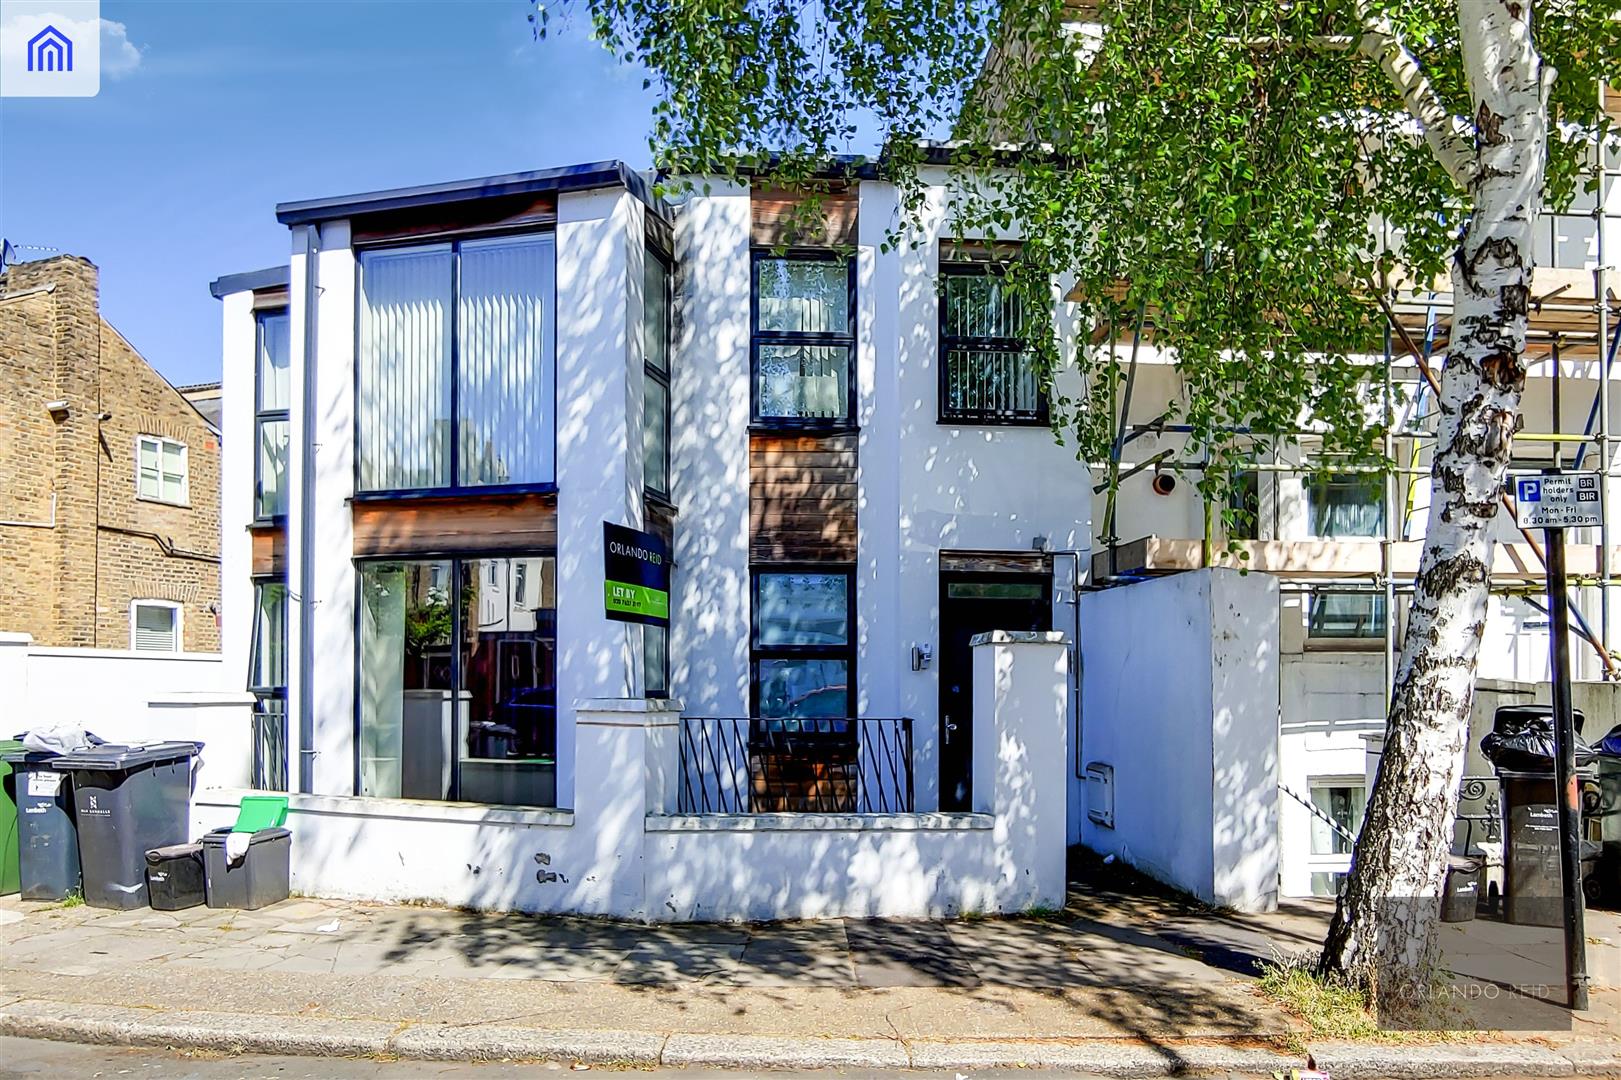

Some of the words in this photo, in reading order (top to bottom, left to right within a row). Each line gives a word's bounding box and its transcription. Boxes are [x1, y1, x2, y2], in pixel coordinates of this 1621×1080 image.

[1580, 479, 1593, 487] BR
[1523, 482, 1537, 500] P
[1580, 493, 1596, 501] BIR
[610, 541, 648, 561] ORLANDO
[649, 551, 662, 566] REID
[612, 586, 624, 597] LET
